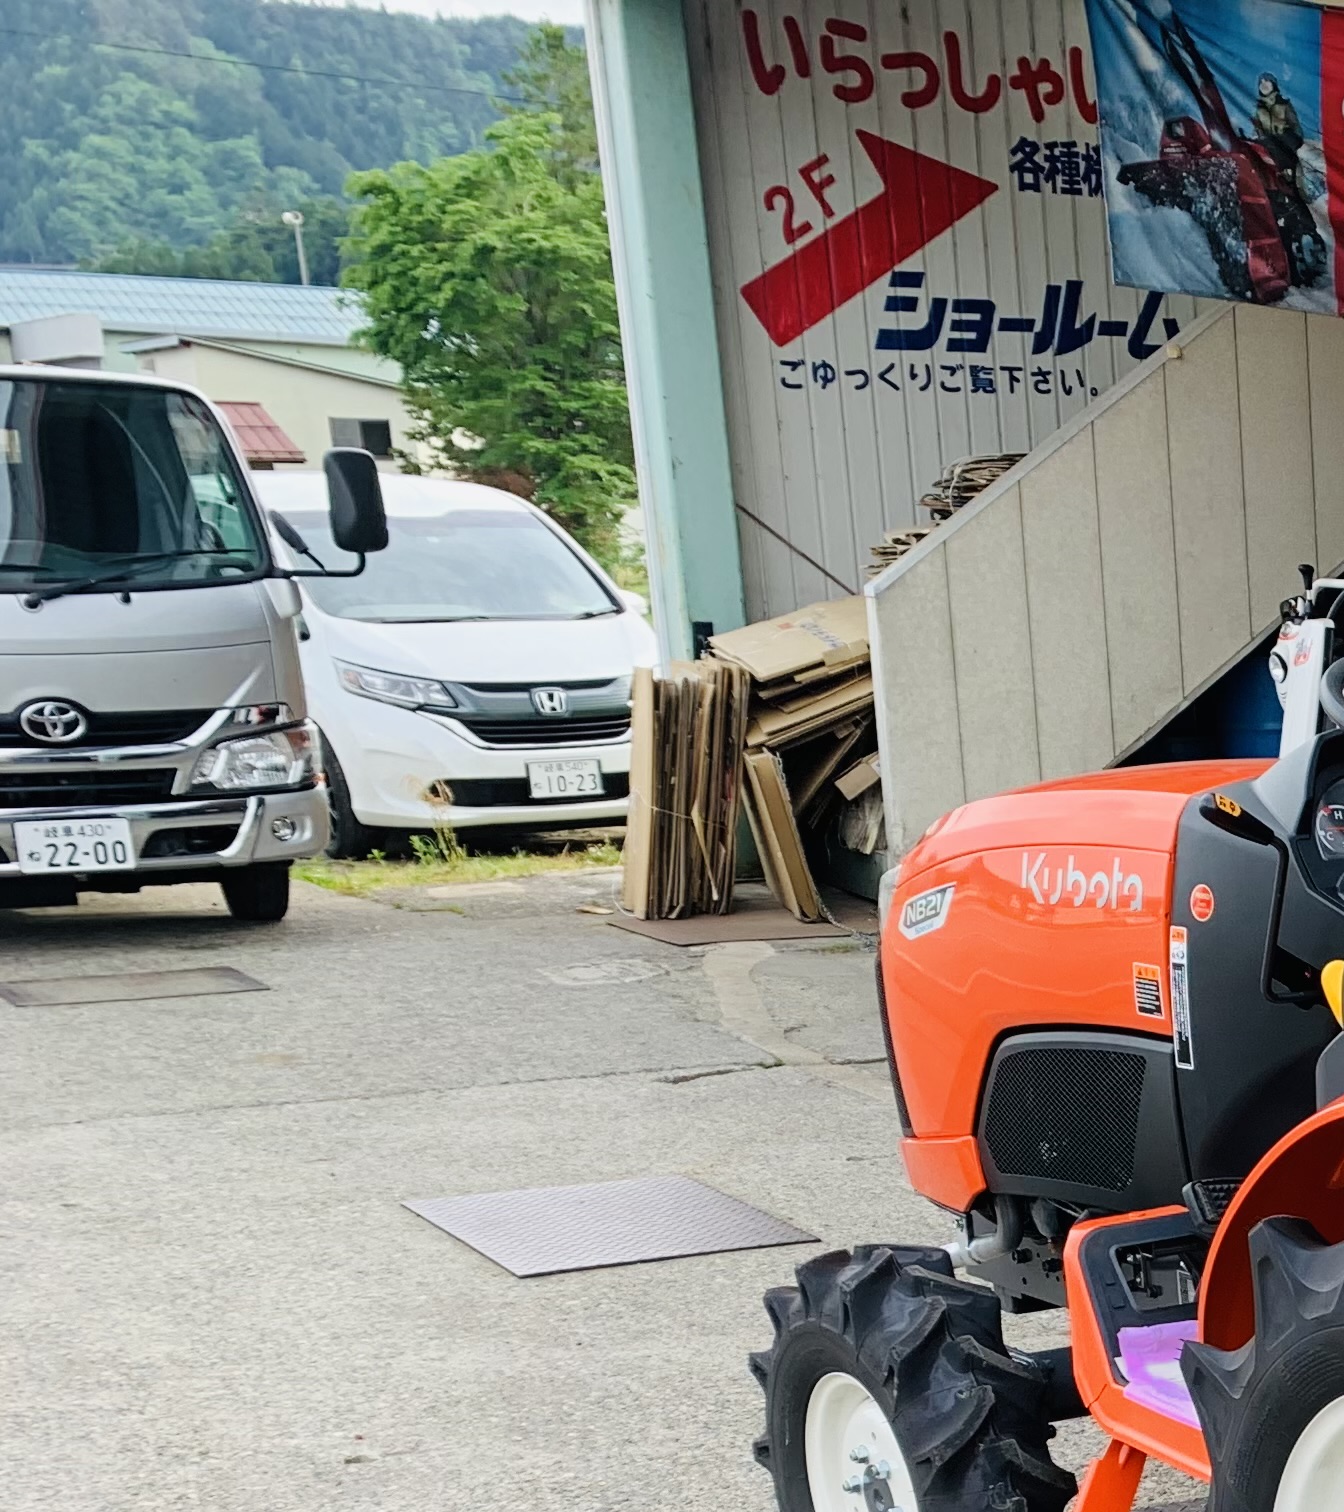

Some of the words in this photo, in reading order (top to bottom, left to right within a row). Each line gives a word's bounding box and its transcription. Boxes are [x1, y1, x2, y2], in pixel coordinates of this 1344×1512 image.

[763, 154, 837, 245] 2F
[875, 270, 1181, 361] ショールーム
[779, 358, 1099, 397] ごゆっくりご覧下さい。
[547, 773, 597, 793] 10-23
[1334, 811, 1343, 820] H
[77, 824, 104, 838] 430
[1326, 831, 1334, 840] C
[45, 840, 127, 867] 22-00
[1020, 851, 1144, 911] Kubota
[906, 892, 942, 926] NB21
